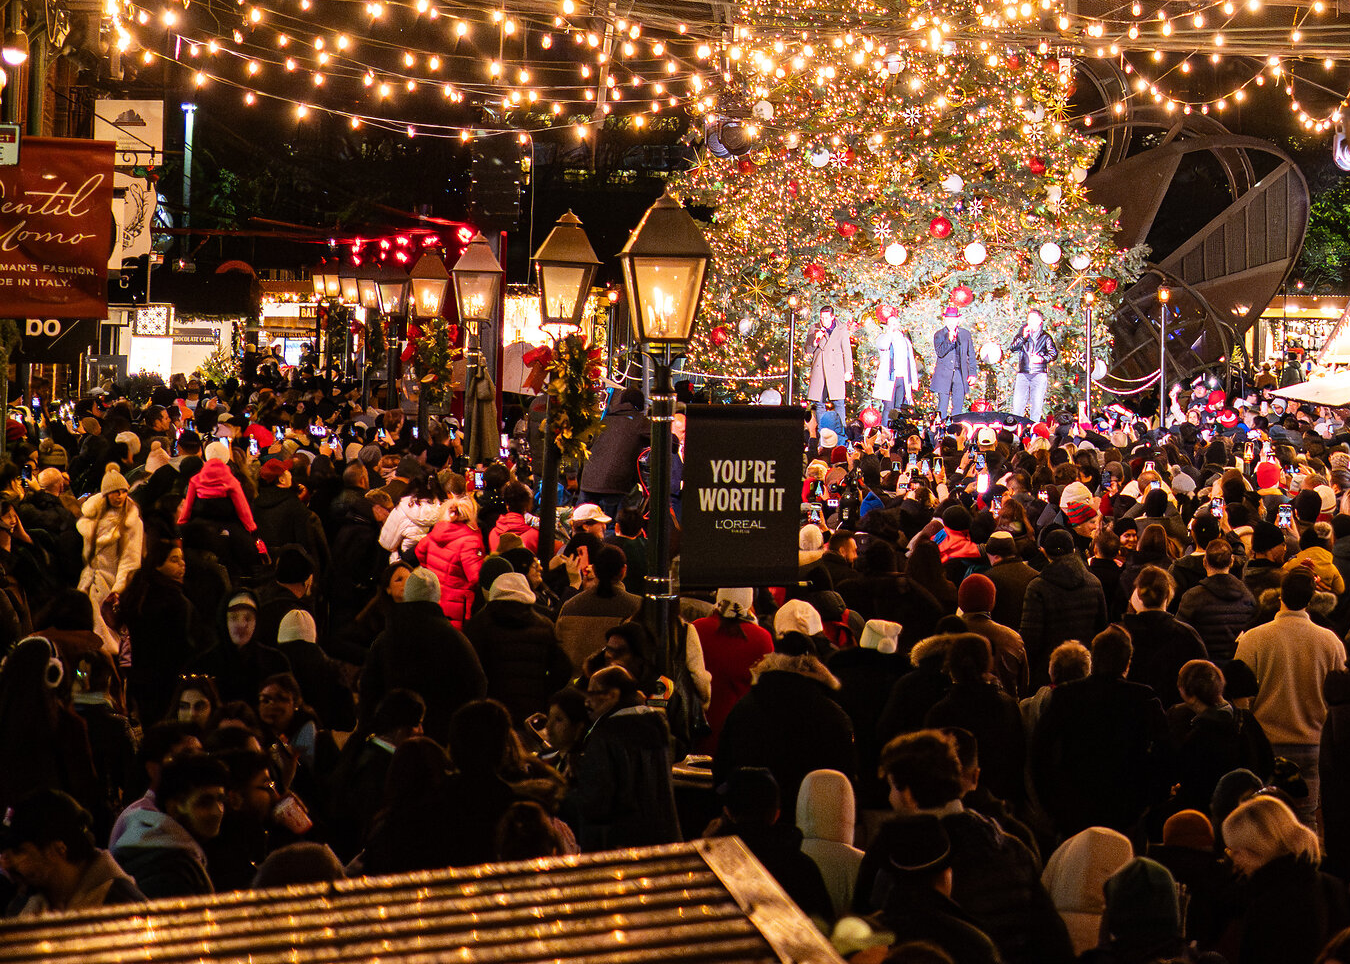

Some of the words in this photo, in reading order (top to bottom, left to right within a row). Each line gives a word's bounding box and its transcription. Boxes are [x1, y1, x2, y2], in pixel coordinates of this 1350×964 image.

[0, 174, 104, 217] entil
[17, 278, 30, 286] IN
[35, 278, 72, 287] ITALY.
[710, 459, 777, 484] YOU'RE
[698, 488, 765, 512] WORTH
[769, 488, 785, 512] IT
